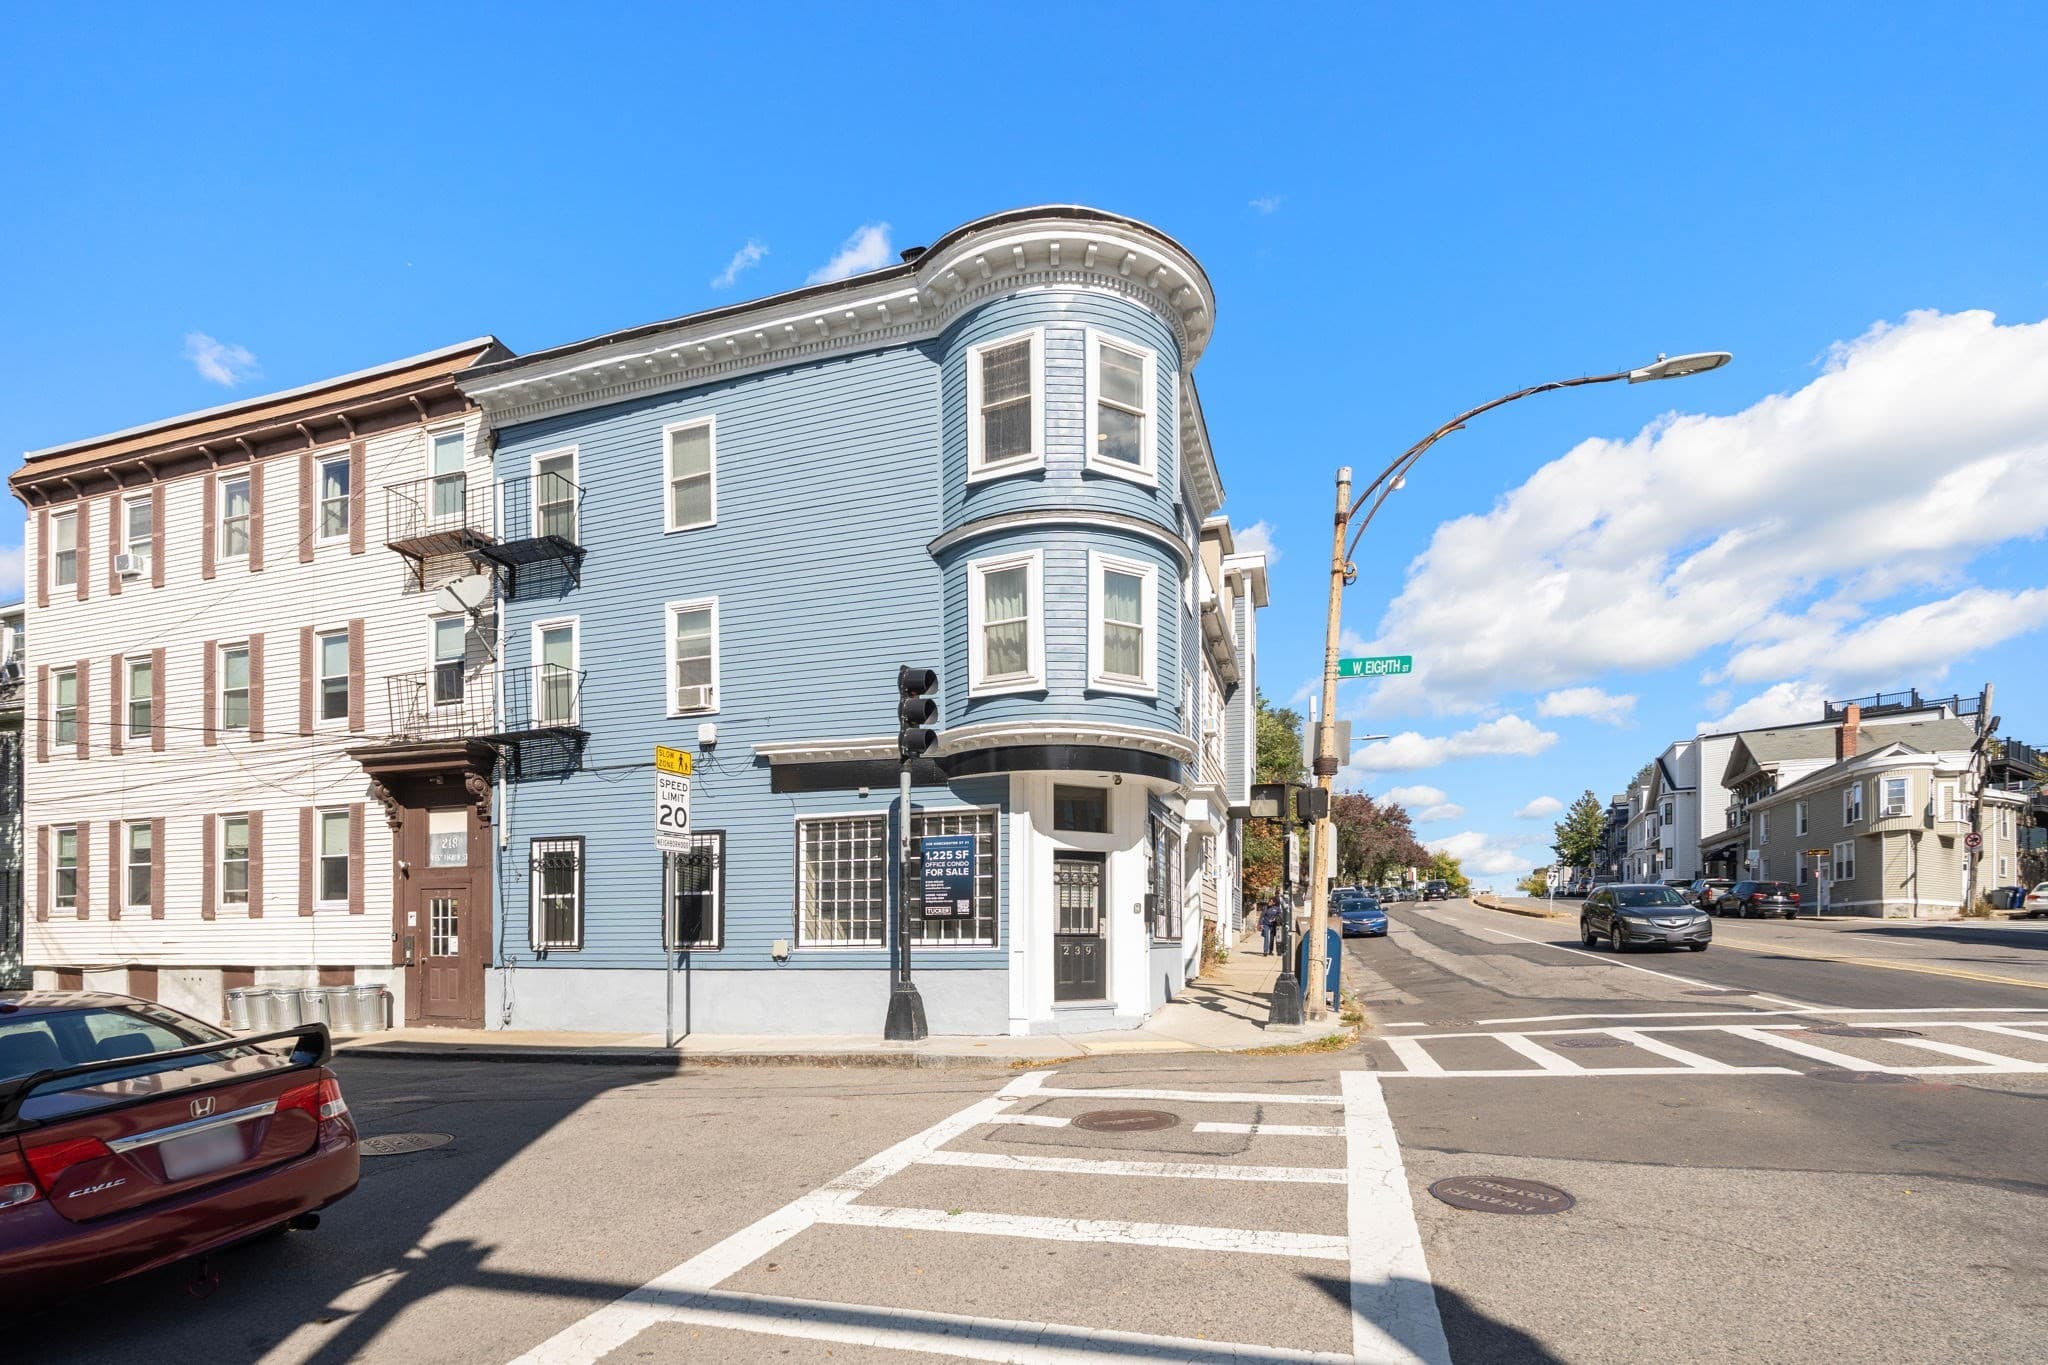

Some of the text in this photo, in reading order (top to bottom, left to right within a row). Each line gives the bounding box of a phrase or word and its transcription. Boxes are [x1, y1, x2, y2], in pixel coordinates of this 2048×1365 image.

[1353, 661, 1362, 675] W
[1365, 659, 1400, 674] EIGHTH
[659, 748, 675, 758] SLOW
[658, 759, 674, 769] ZONE
[660, 778, 688, 792] SPEED
[662, 792, 685, 803] LIMIT
[660, 804, 687, 828] 20
[955, 850, 969, 860] SF
[925, 867, 969, 876] FOR SALE
[1063, 946, 1092, 956] 239
[69, 1177, 126, 1198] CIVIC
